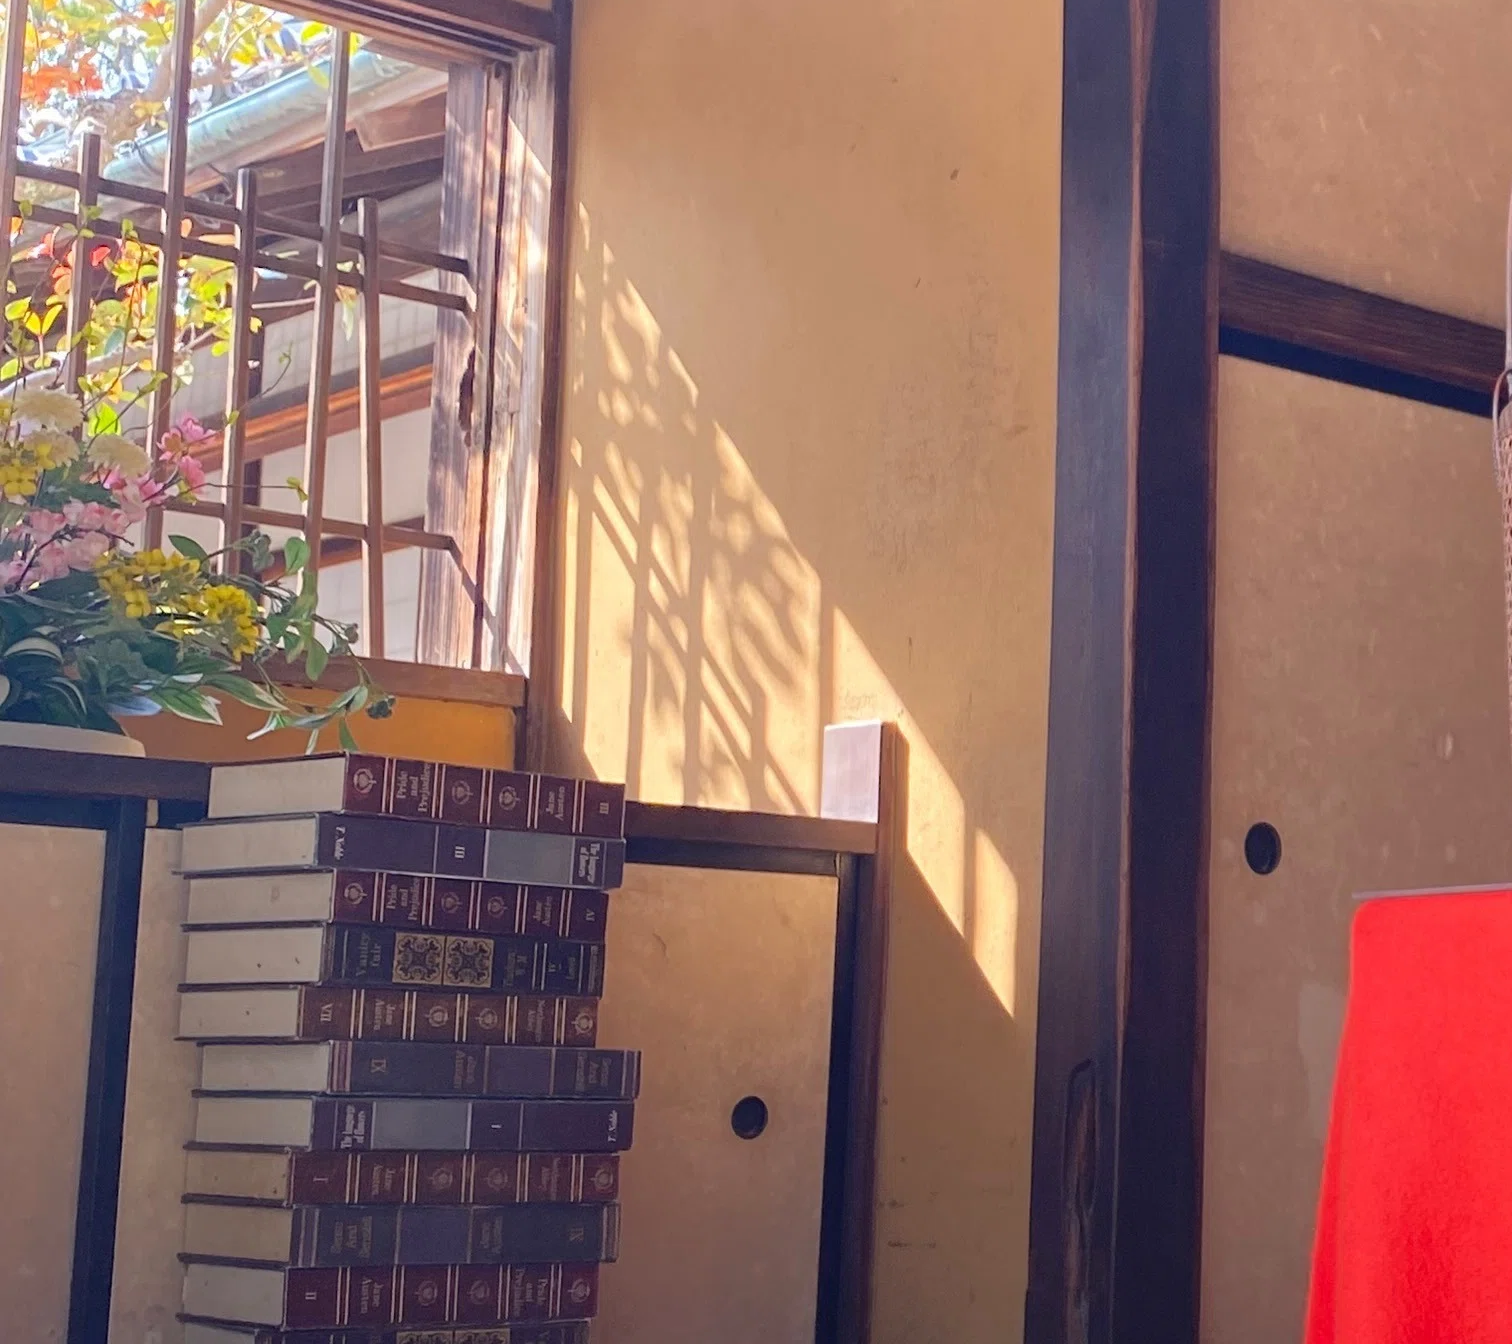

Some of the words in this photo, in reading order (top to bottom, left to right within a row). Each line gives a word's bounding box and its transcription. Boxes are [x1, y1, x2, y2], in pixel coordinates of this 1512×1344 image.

[396, 770, 408, 799] Pride
[409, 775, 419, 796] and
[454, 846, 465, 858] III
[386, 884, 397, 909] Pride
[320, 1002, 334, 1022] VII
